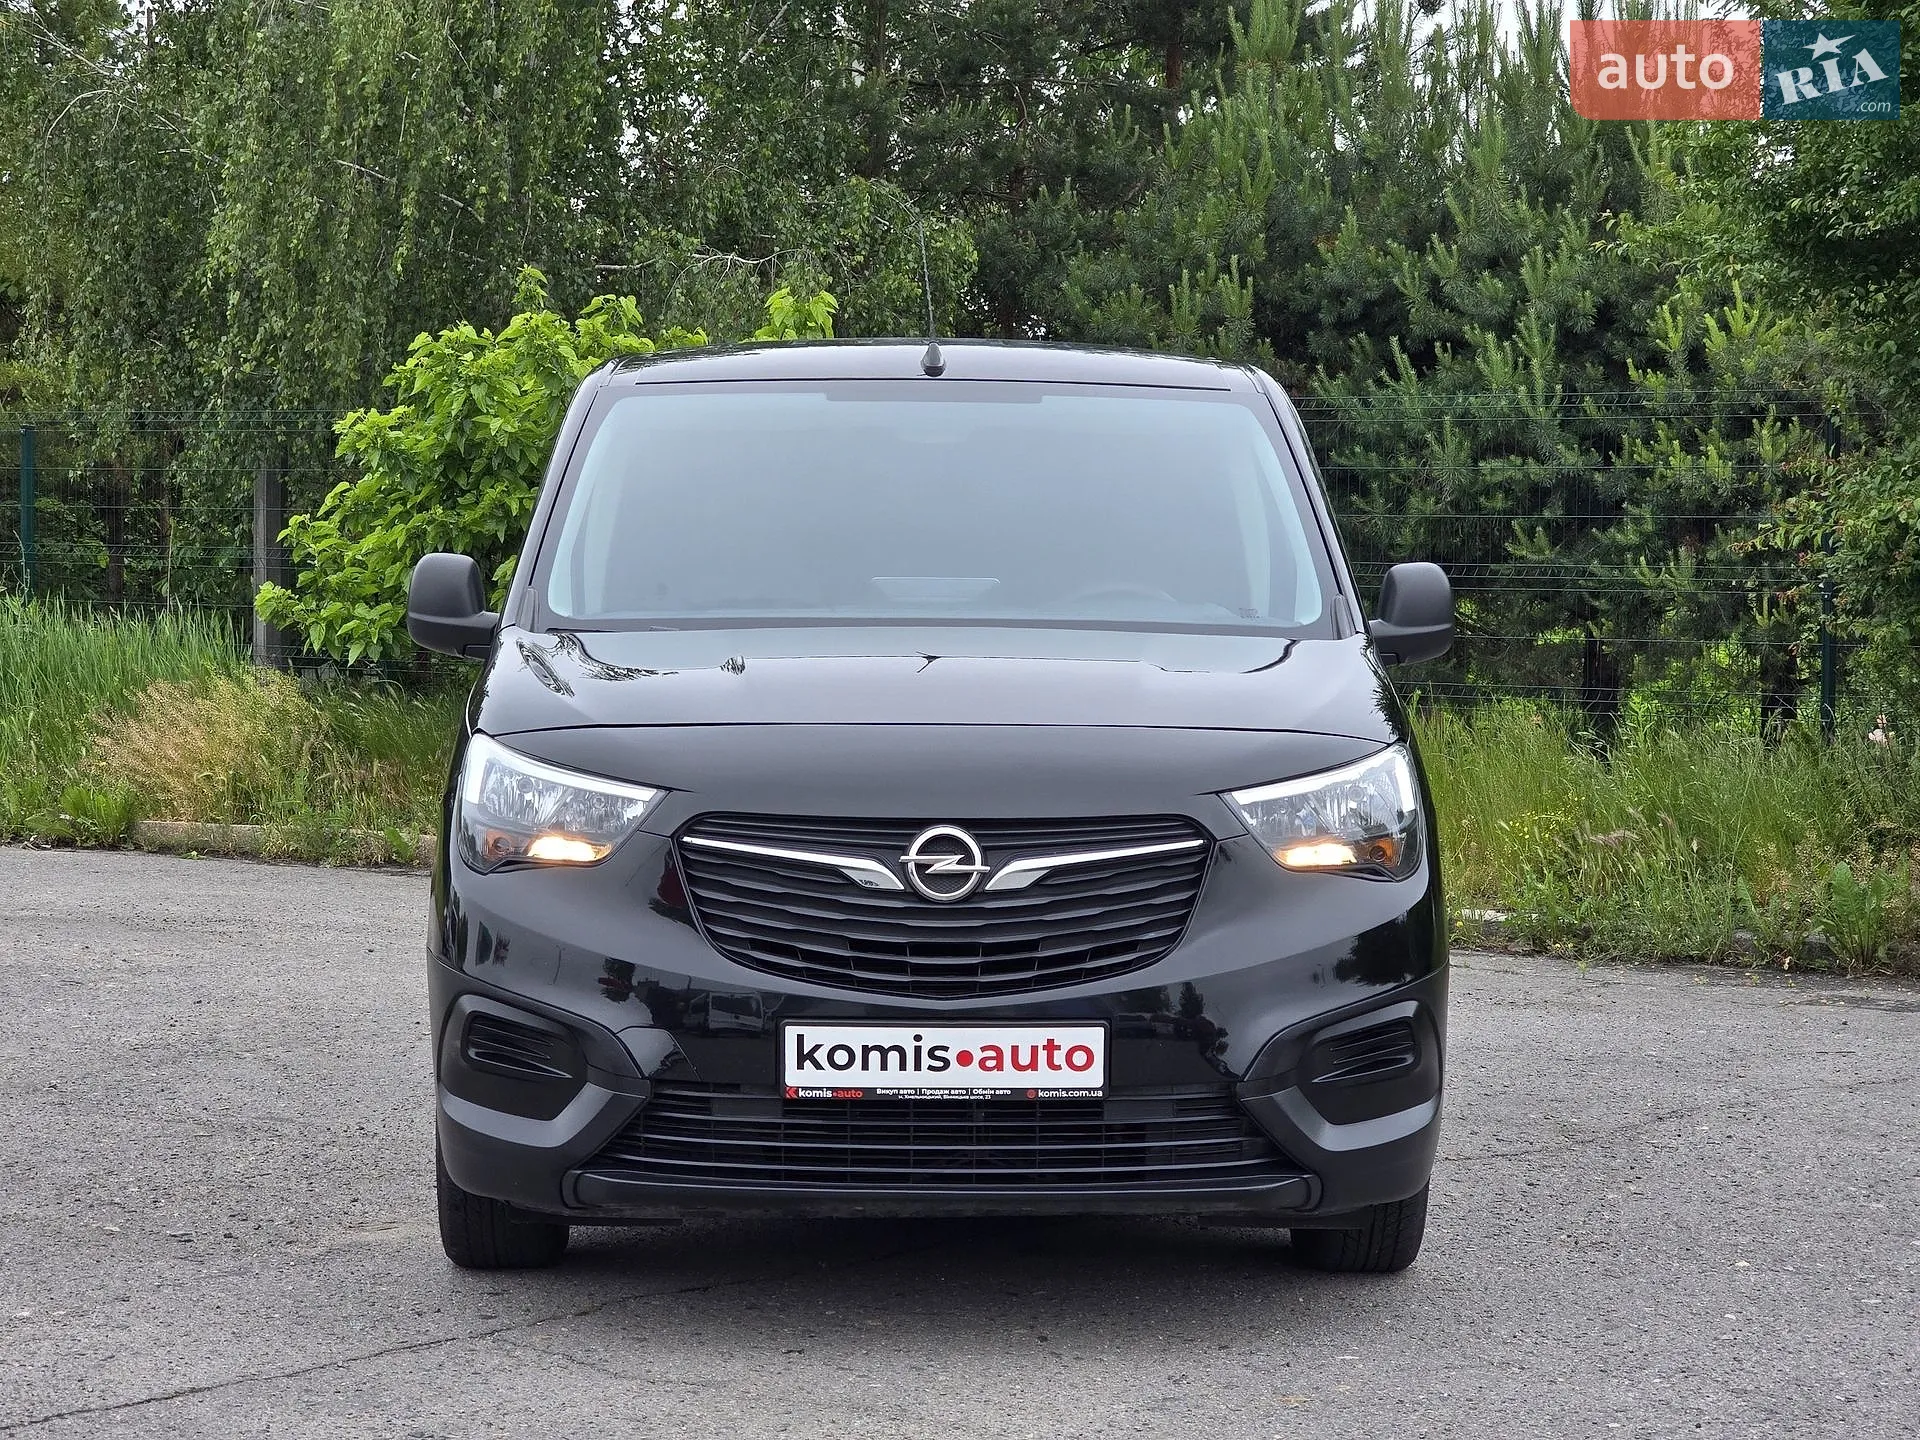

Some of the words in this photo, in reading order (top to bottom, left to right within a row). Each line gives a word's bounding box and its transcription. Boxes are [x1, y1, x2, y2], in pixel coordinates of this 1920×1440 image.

[876, 1088, 898, 1096] Викуп
[921, 1088, 949, 1096] Продаж
[1038, 1088, 1103, 1098] komis.com.ua
